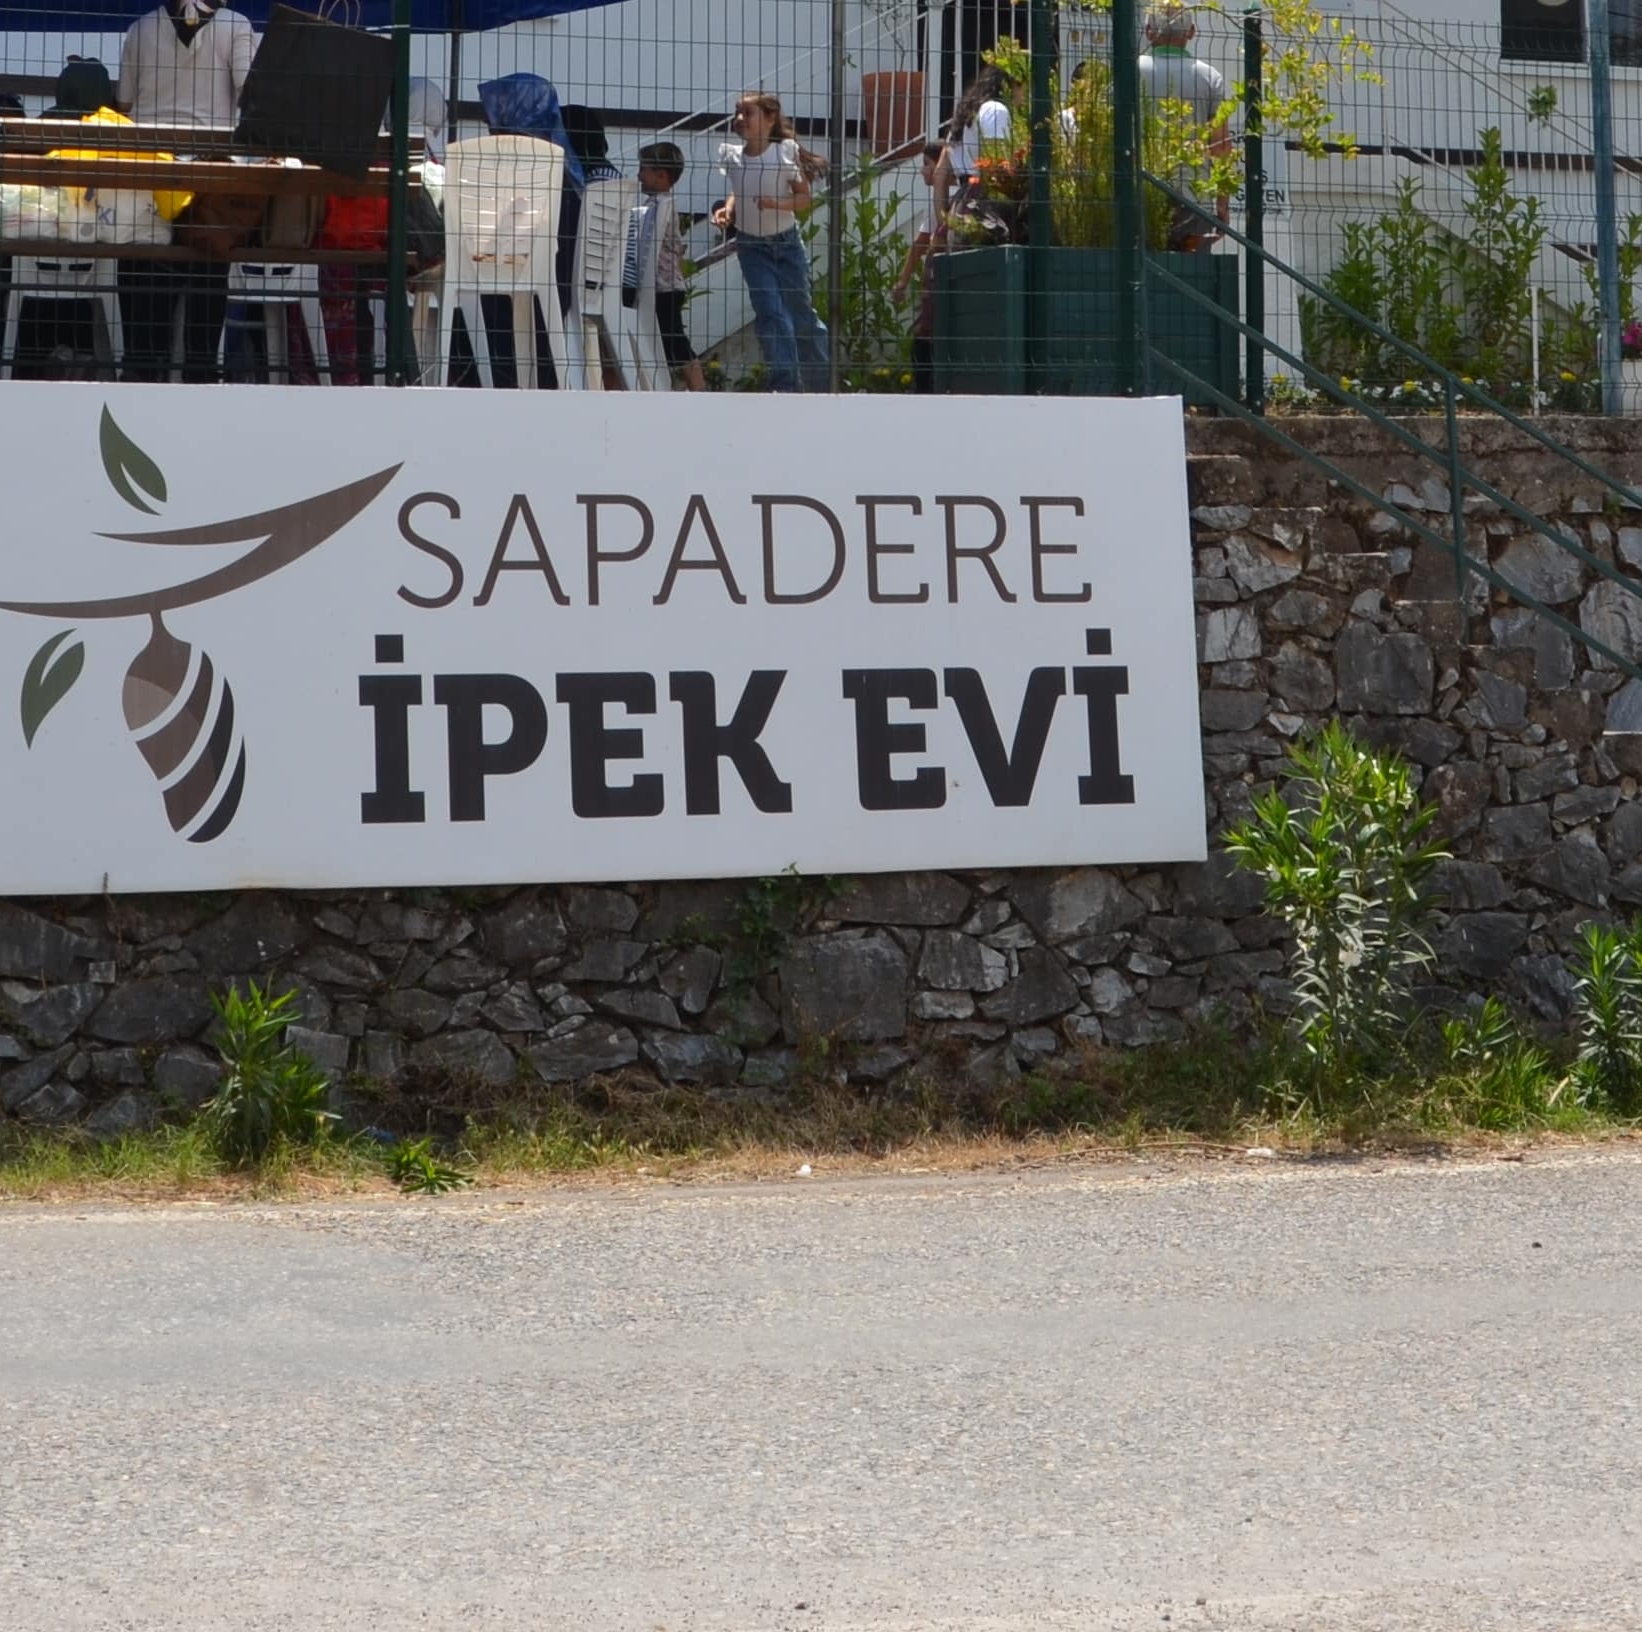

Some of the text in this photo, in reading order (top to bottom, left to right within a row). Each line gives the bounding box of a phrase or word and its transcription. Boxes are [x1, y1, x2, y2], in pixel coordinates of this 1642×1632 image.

[396, 491, 1093, 609] SAPADERE
[358, 627, 1136, 824] İPEK EVİ
